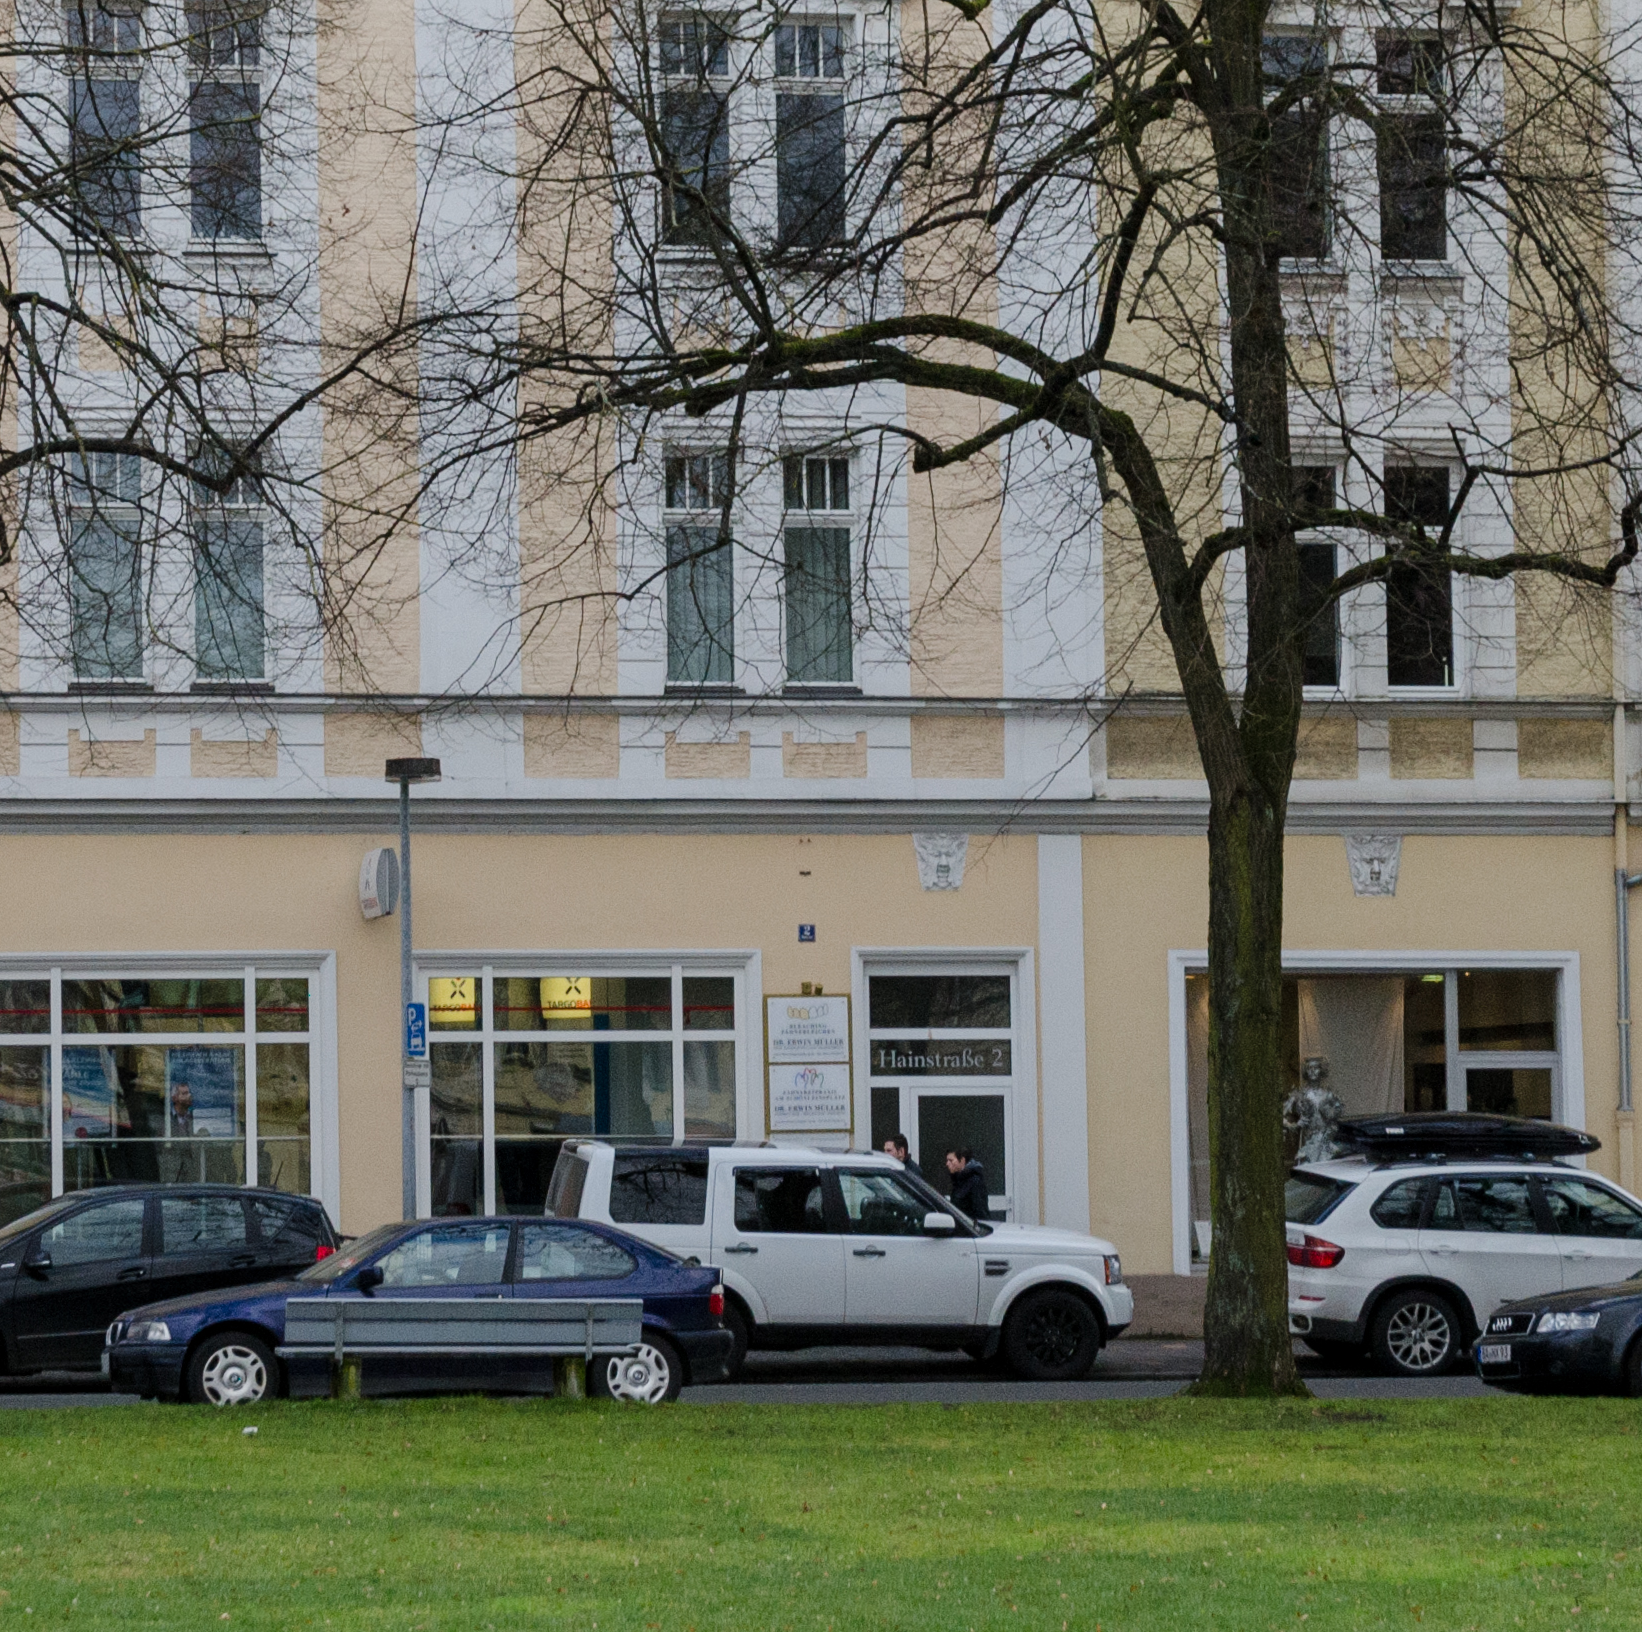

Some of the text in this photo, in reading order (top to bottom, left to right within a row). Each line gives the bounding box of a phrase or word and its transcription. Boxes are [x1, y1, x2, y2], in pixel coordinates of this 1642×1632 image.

[548, 1000, 591, 1009] TARGOBA
[408, 1007, 417, 1025] P
[879, 1048, 1003, 1068] Hainstraße 2
